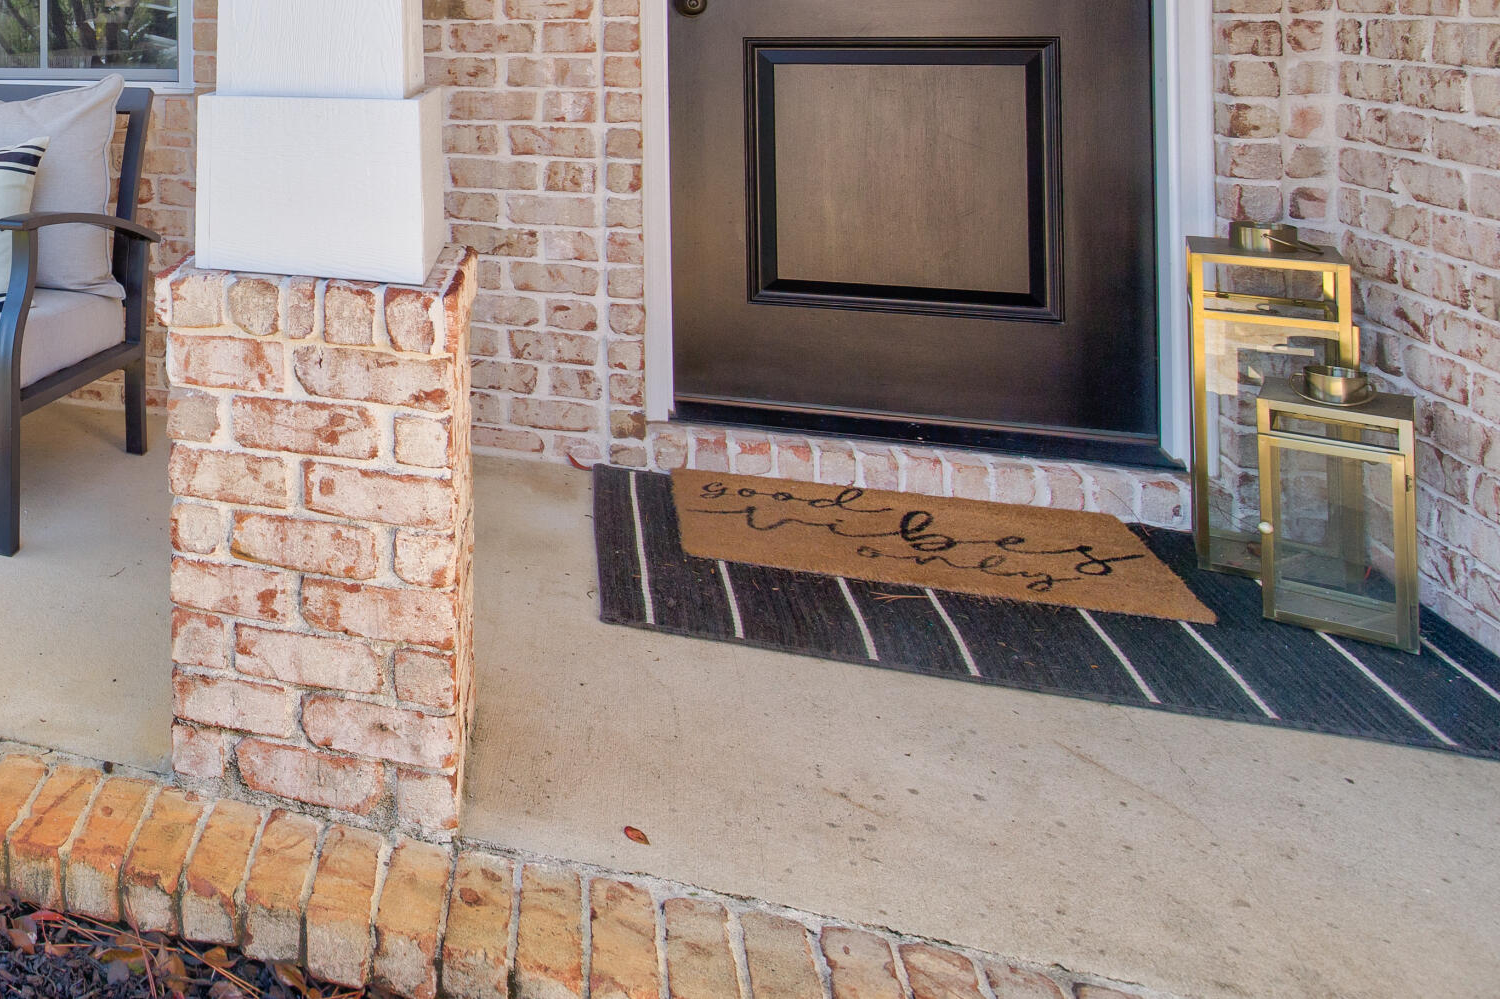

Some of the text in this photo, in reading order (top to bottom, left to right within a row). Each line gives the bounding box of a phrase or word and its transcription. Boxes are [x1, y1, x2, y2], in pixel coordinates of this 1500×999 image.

[700, 482, 893, 513] good
[687, 507, 1146, 576] vibes
[856, 545, 1082, 592] only
